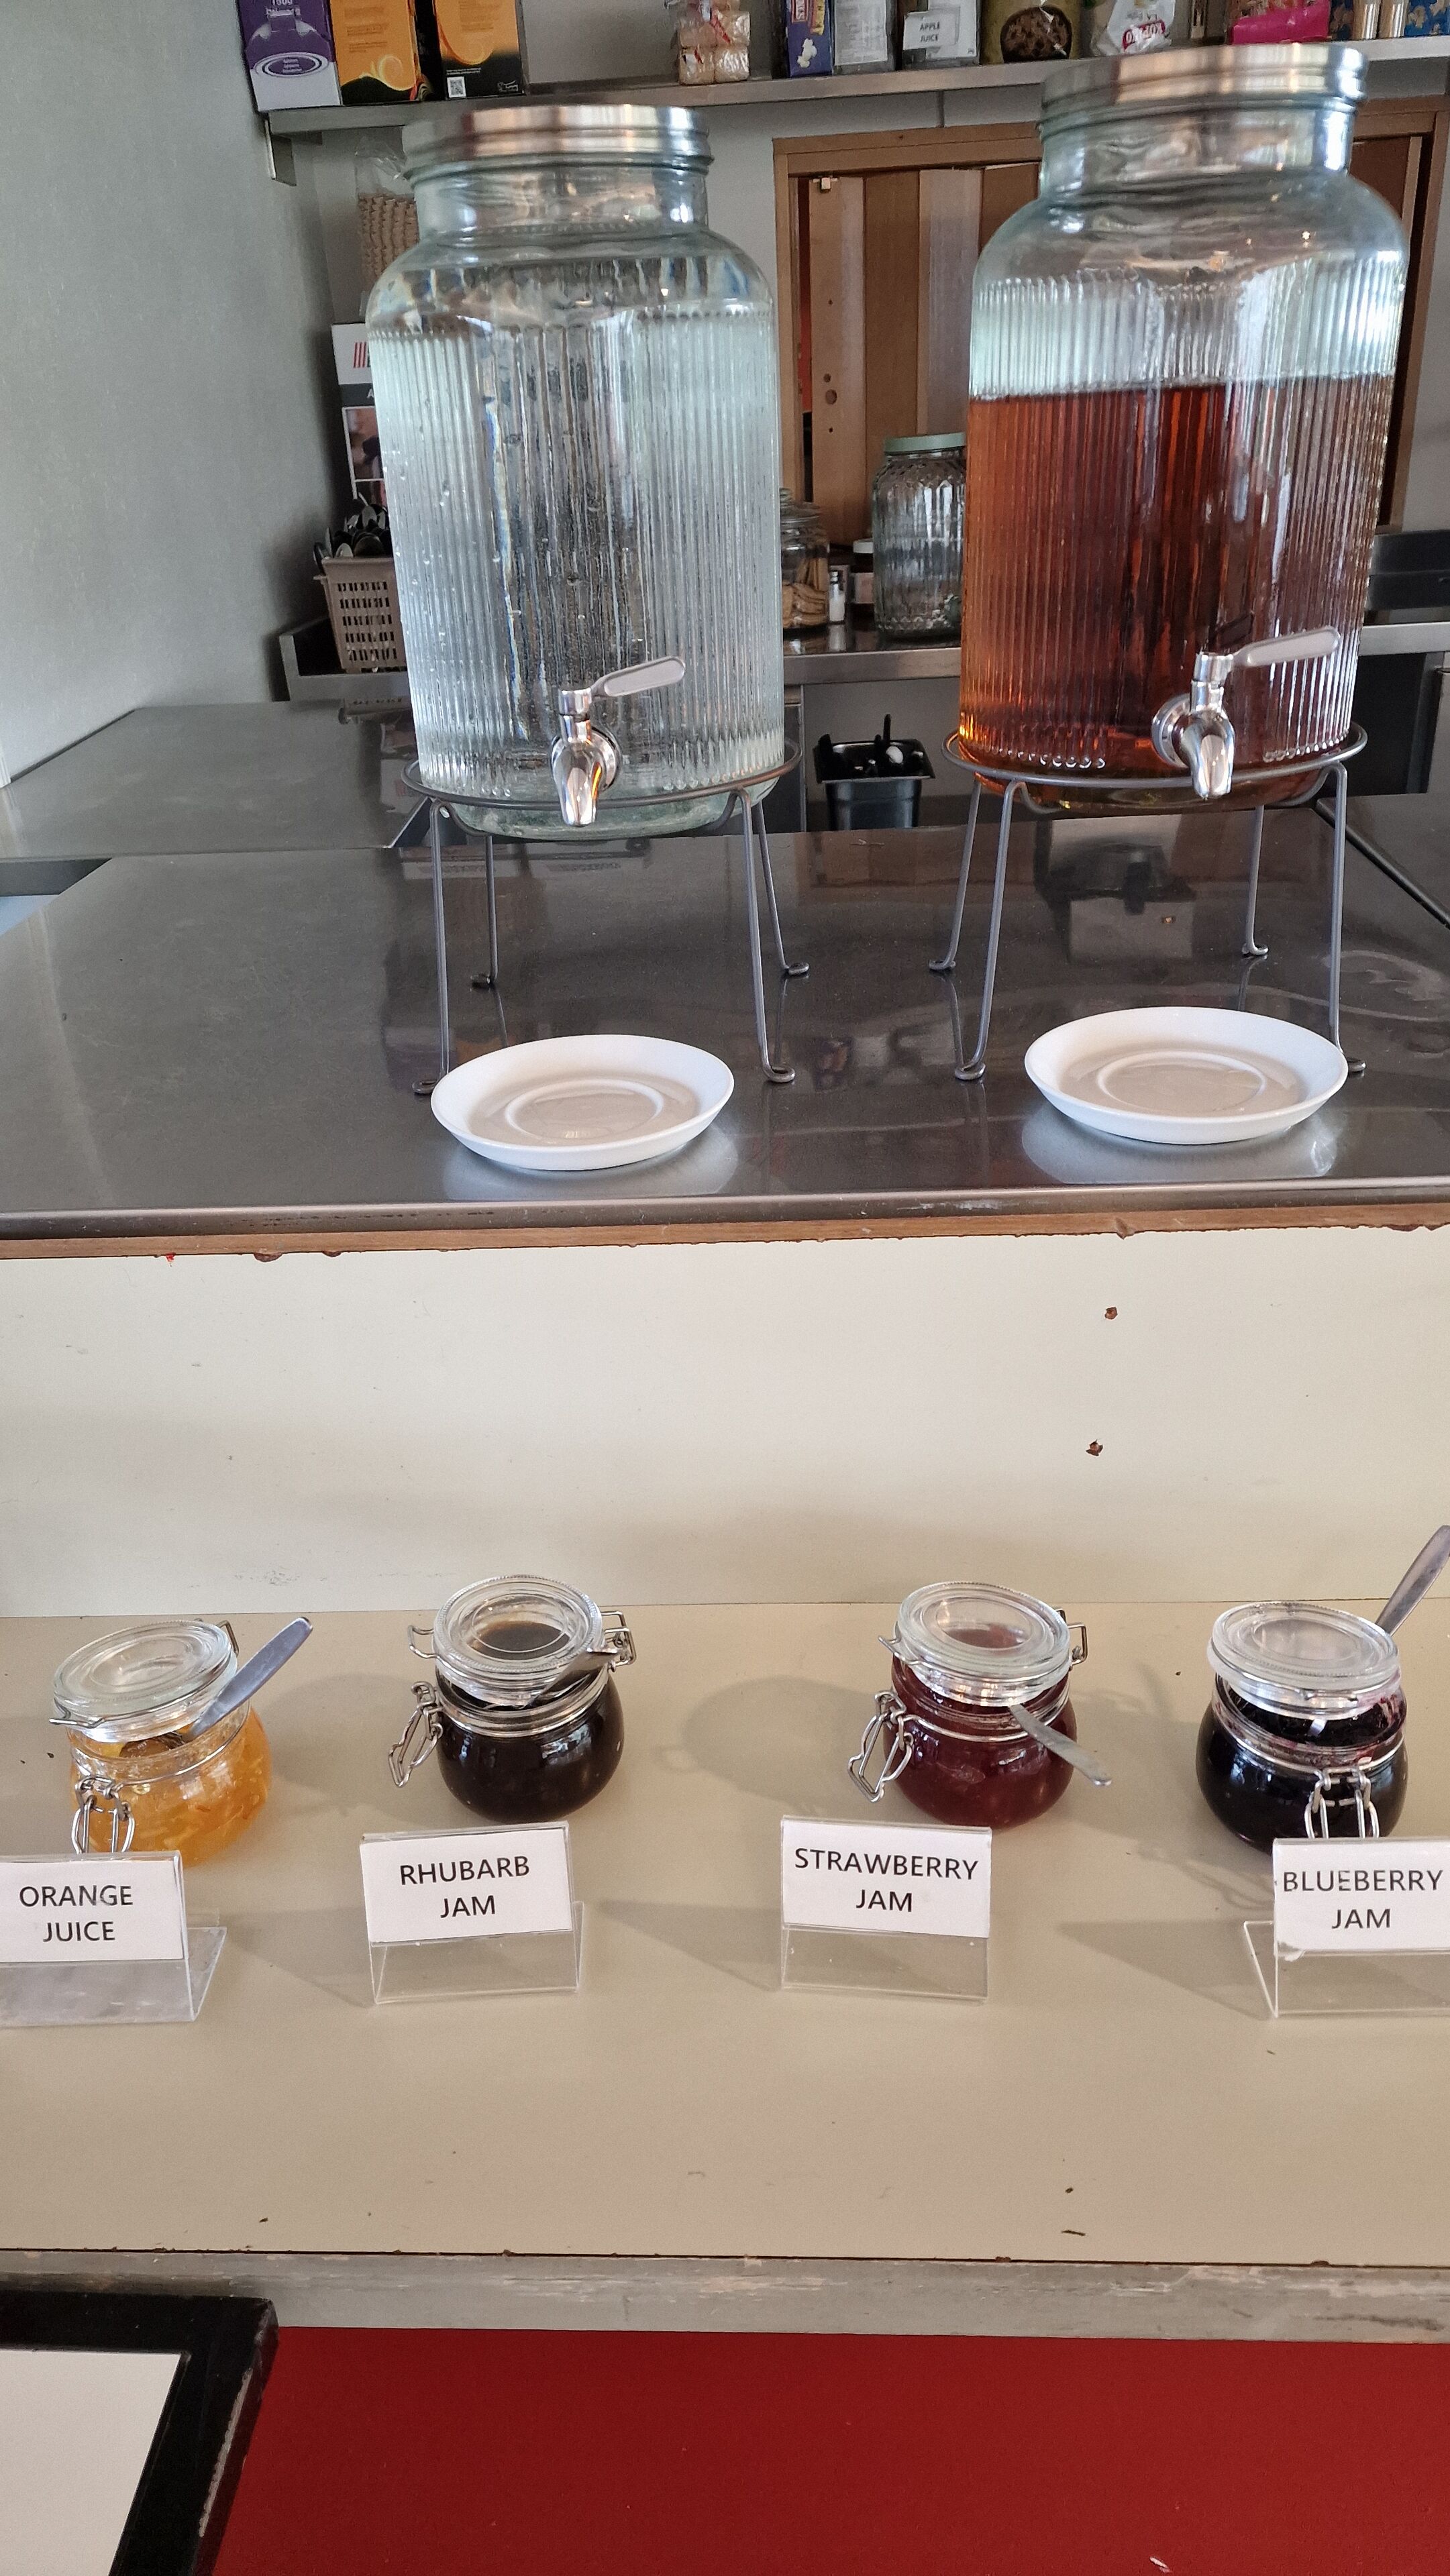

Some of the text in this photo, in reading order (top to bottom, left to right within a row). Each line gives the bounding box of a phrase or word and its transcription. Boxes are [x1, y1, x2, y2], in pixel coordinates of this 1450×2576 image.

[919, 21, 940, 31] APPLE
[920, 33, 939, 42] JUICE
[400, 1856, 530, 1886] RHUBARB
[794, 1847, 979, 1880] STRAWBERRY
[1283, 1869, 1444, 1892] BLUEBERRY
[19, 1885, 134, 1907] ORANGE
[440, 1895, 496, 1919] JAM
[856, 1889, 913, 1913] JAM
[1331, 1908, 1391, 1929] JAM
[43, 1921, 115, 1943] JUICE
